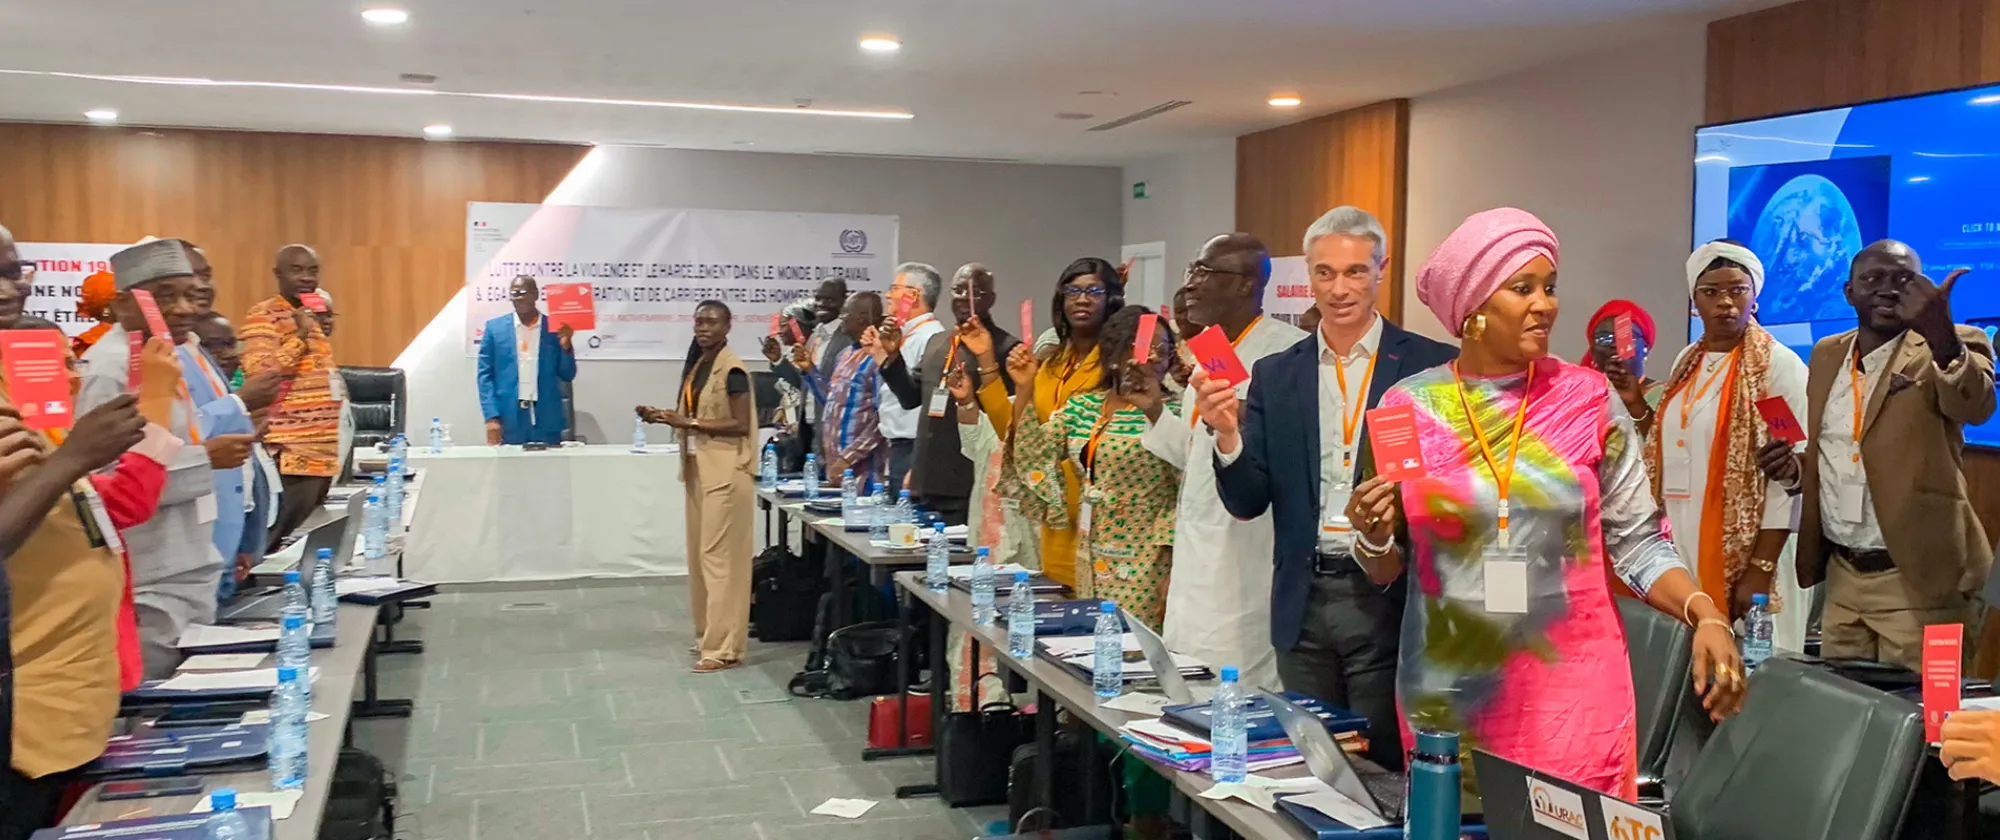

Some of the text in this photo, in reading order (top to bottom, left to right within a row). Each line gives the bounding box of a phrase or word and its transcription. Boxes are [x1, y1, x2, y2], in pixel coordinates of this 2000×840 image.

[490, 262, 521, 277] LUTTE
[525, 262, 563, 277] CONTRE
[566, 263, 578, 277] LA
[580, 263, 630, 277] VIOLENCE
[632, 263, 643, 277] ET
[647, 264, 658, 278] LE
[734, 265, 760, 279] DANS
[763, 265, 774, 279] LE
[777, 266, 811, 280] MONDE
[832, 267, 871, 281] TRAVAIL
[633, 287, 645, 302] ET
[648, 287, 662, 302] DE
[716, 287, 747, 303] ENTRE
[749, 288, 766, 303] LES
[1276, 285, 1308, 298] SALAIRE
[1555, 805, 1584, 827] URAC
